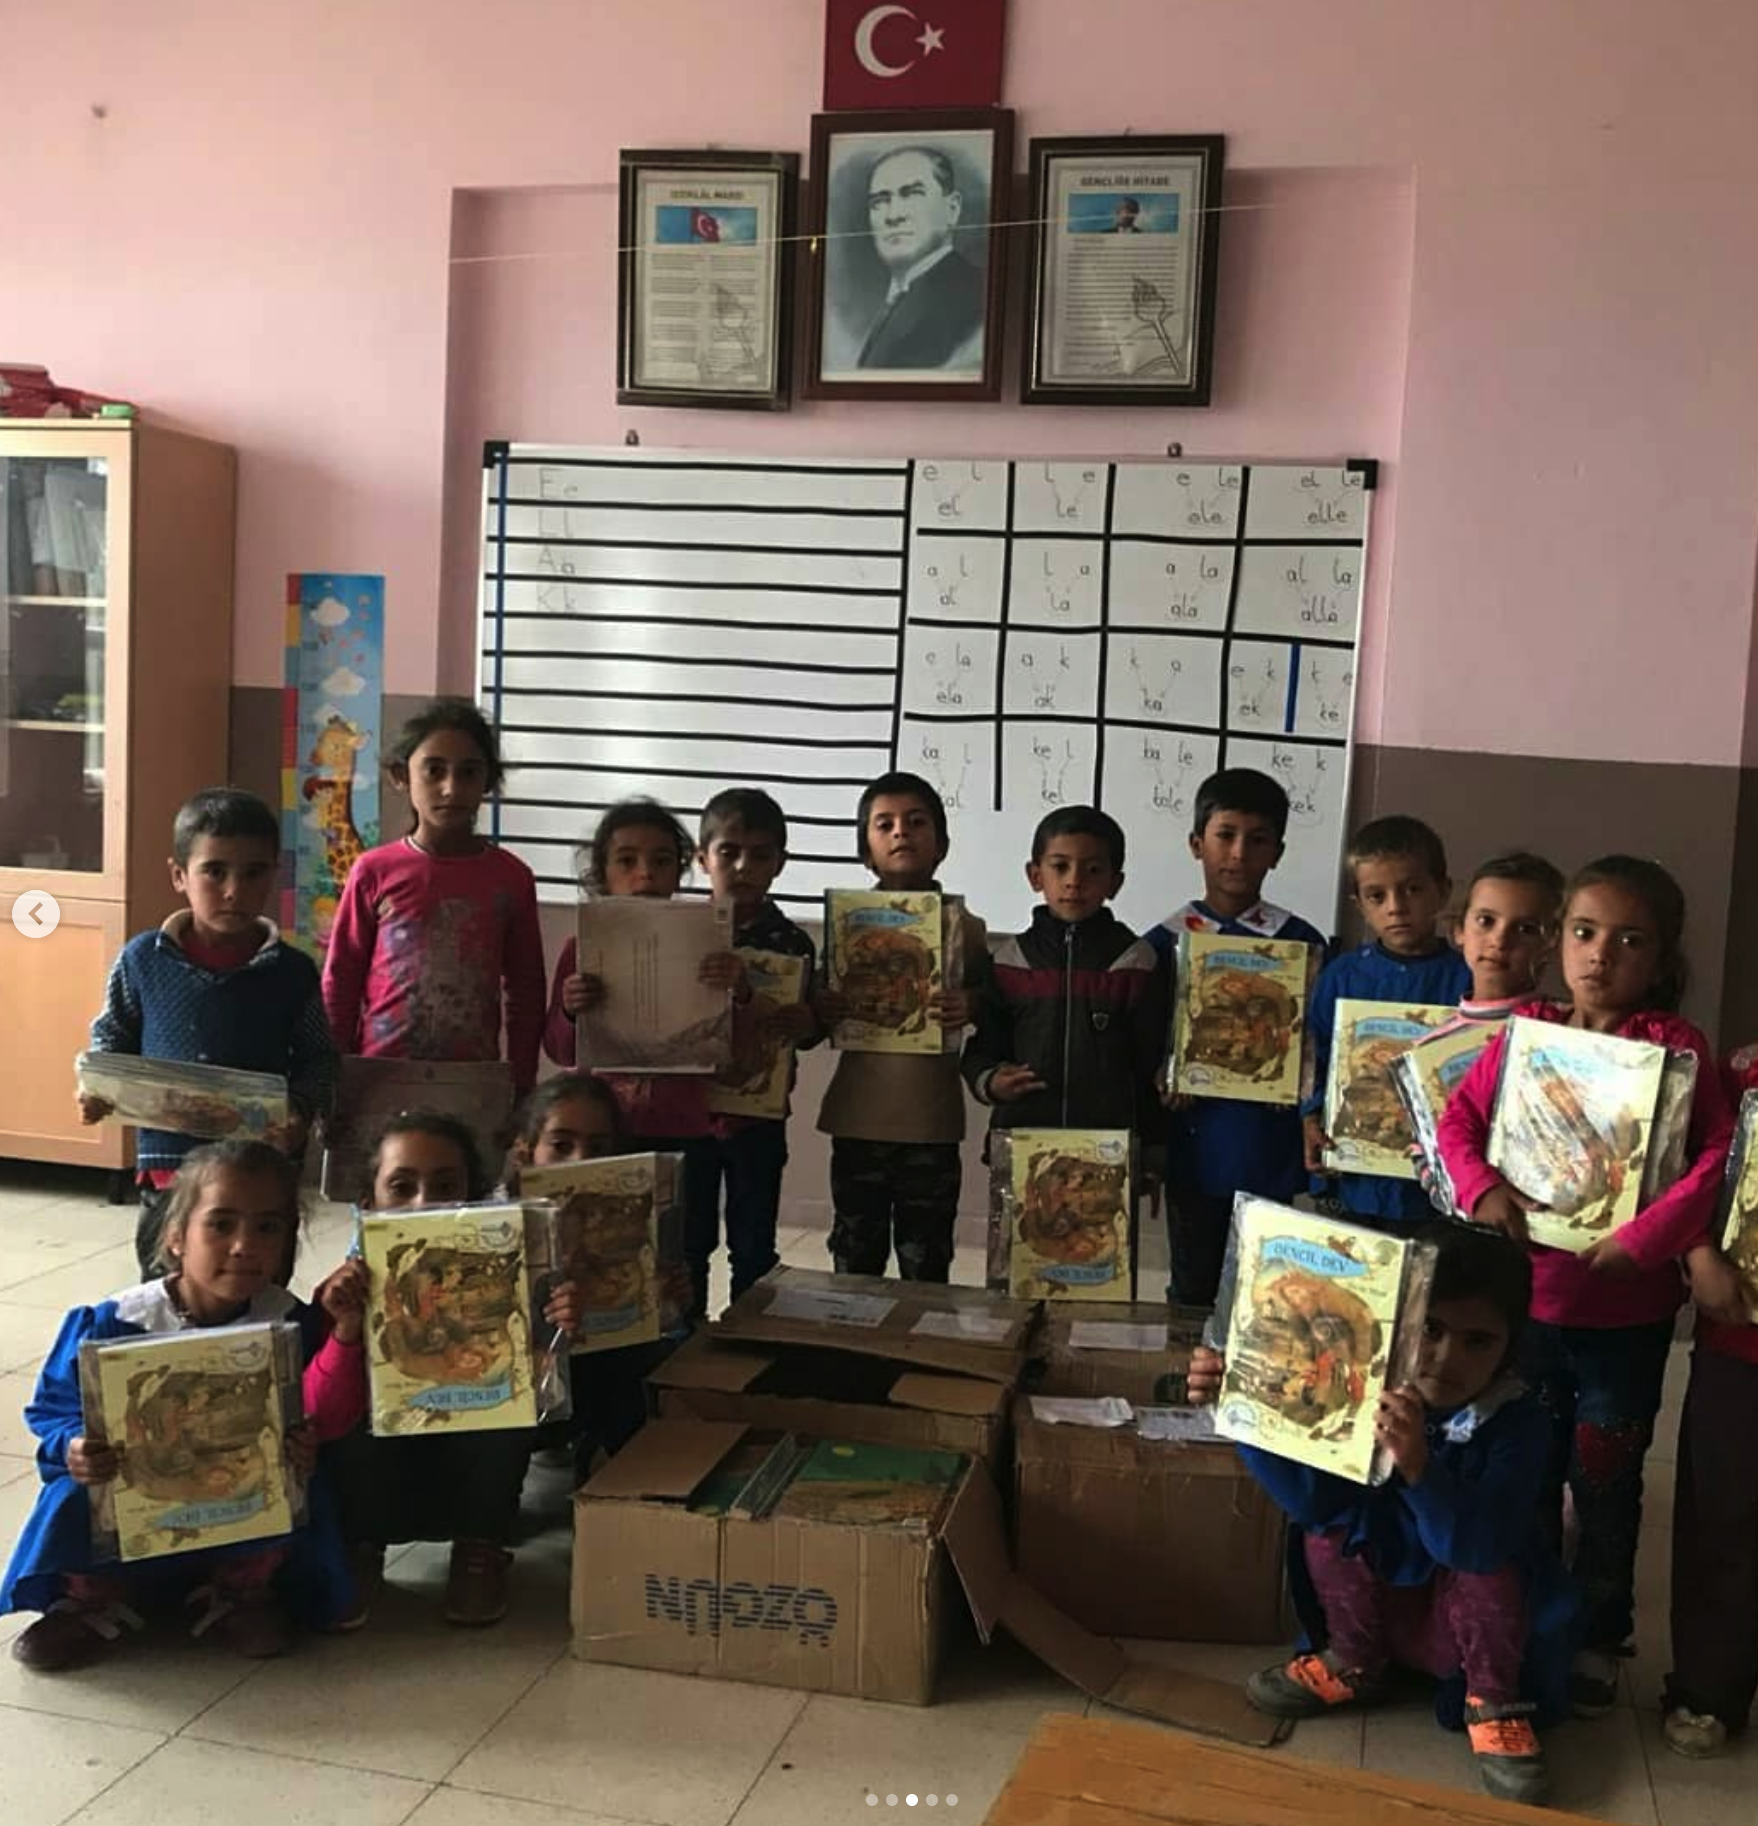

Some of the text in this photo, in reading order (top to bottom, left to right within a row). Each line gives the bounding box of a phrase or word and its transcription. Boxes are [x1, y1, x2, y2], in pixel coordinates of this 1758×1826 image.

[921, 465, 938, 481] e
[1082, 471, 1096, 483] e
[1176, 467, 1239, 488] e le
[1300, 469, 1361, 488] el le
[938, 495, 962, 516] el
[1056, 496, 1079, 518] le
[1187, 499, 1224, 524] ele
[1307, 502, 1347, 524] elle
[926, 565, 938, 577] a
[1080, 564, 1090, 576] a
[1165, 554, 1219, 579] a la
[1286, 555, 1352, 585] al la
[1050, 592, 1070, 612] la
[1170, 593, 1199, 618] ala
[1300, 595, 1338, 622] alla
[955, 641, 971, 667] la
[1020, 653, 1034, 667] a
[1231, 664, 1245, 677] e
[936, 682, 963, 705] ela
[1239, 697, 1261, 717] ek
[1177, 740, 1193, 766] le
[1271, 743, 1294, 769] ke
